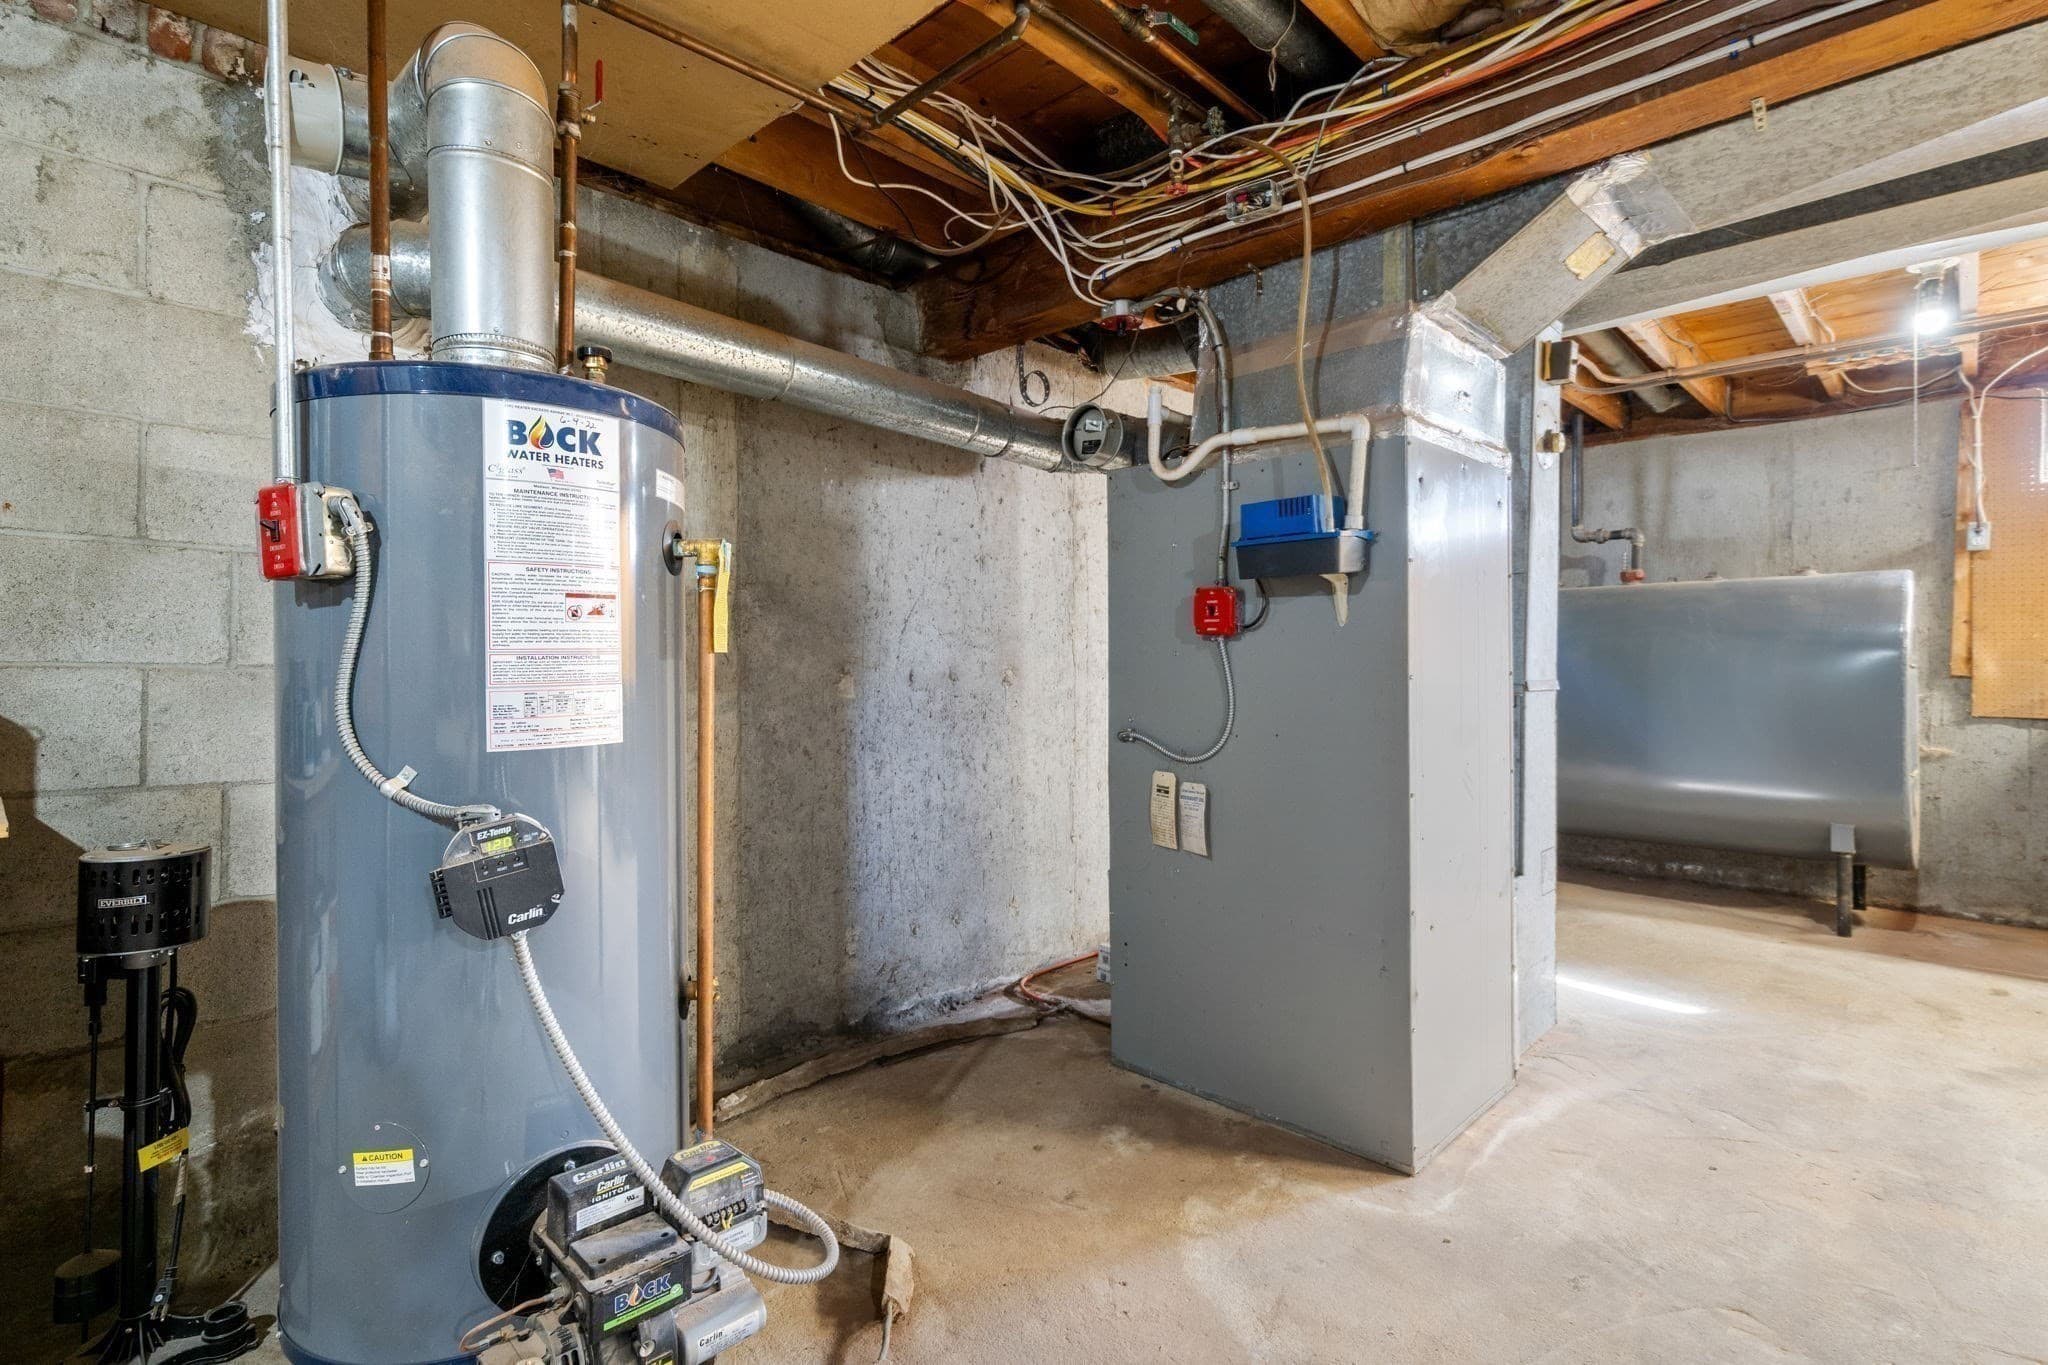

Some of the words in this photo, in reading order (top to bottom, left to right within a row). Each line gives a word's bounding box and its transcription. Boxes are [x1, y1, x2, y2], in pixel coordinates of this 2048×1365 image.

[507, 415, 602, 457] BOCK
[555, 453, 604, 470] HEATERS
[513, 488, 558, 498] MAINTENANCE
[550, 567, 591, 575] INSTRUCTIONS
[476, 825, 512, 840] EZ-Temp
[100, 897, 144, 907] EVERBILT
[507, 905, 544, 925] Carlin
[368, 1152, 403, 1162] CAUTION
[573, 1159, 626, 1184] Carlin
[597, 1174, 628, 1193] Carlin
[591, 1184, 630, 1204] IGNITOR
[614, 1272, 672, 1314] BOCK
[699, 1331, 723, 1347] Carlin
